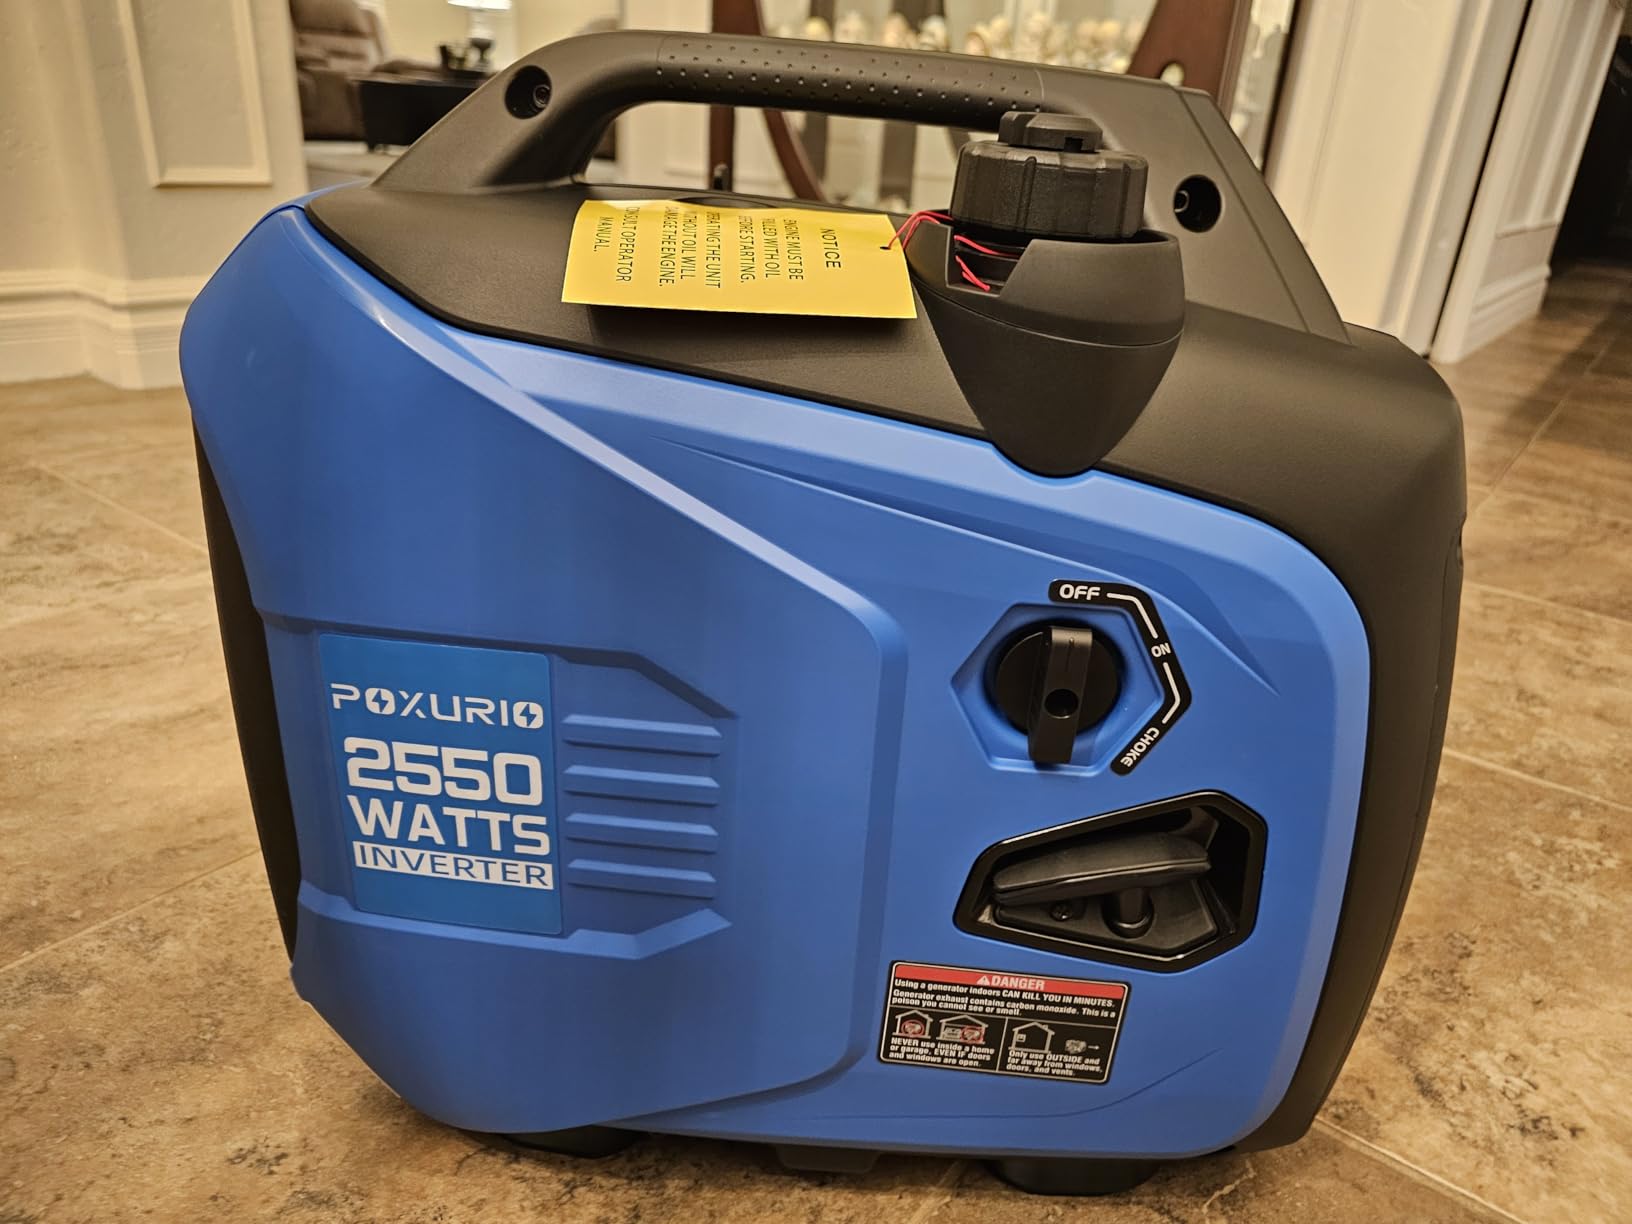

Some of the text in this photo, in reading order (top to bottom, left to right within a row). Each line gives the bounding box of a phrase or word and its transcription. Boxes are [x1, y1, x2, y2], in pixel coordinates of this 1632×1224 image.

[593, 216, 614, 252] MANUAL.
[662, 230, 677, 245] THE
[680, 210, 698, 280] THOUT OIL WILL
[616, 231, 635, 282] OPERATOR
[706, 244, 721, 261] THE
[740, 235, 756, 283] STARTING.
[763, 239, 779, 260] WITH
[787, 241, 803, 266] MUST
[820, 228, 841, 268] NOTICE
[659, 246, 676, 287] ENGINE.
[705, 263, 721, 288] UNIT
[765, 261, 780, 279] OIL
[788, 268, 804, 280] BE
[1059, 584, 1101, 600] OFF
[1151, 642, 1171, 658] ON
[330, 682, 544, 729] POXURIO
[1120, 727, 1160, 767] CHOKE
[343, 736, 543, 806] 2550
[347, 794, 551, 856] WATTS
[358, 844, 549, 887] INVERTER
[894, 979, 919, 990] Using
[927, 982, 968, 994] generator
[970, 986, 1001, 997] indoors
[1002, 990, 1020, 999] CAN
[1022, 991, 1041, 1000] KILL
[1043, 993, 1061, 1003] YOU
[1062, 995, 1072, 1004] IN
[1073, 996, 1116, 1008] MINUTES.
[991, 975, 1046, 991] DANGER
[892, 997, 920, 1006] poison
[921, 1000, 937, 1008] you
[939, 1001, 967, 1010] cannot
[893, 989, 1116, 1019] Generator exhaust contains carbon monoxide. This is a
[891, 1036, 919, 1046] NEVER
[920, 1041, 936, 1049] use
[937, 1042, 962, 1051] inside
[971, 1045, 995, 1054] home
[934, 1048, 956, 1057] EVEN
[957, 1050, 966, 1058] IF
[967, 1051, 991, 1061] doors
[889, 1051, 905, 1059] and
[906, 1053, 941, 1063] windows
[1007, 1056, 1019, 1064] far
[1020, 1058, 1043, 1067] away
[1044, 1060, 1063, 1068] from
[1009, 1050, 1028, 1059] Only
[1046, 1053, 1083, 1064] OUTSIDE
[1084, 1057, 1100, 1065] and
[1034, 1066, 1050, 1074] and
